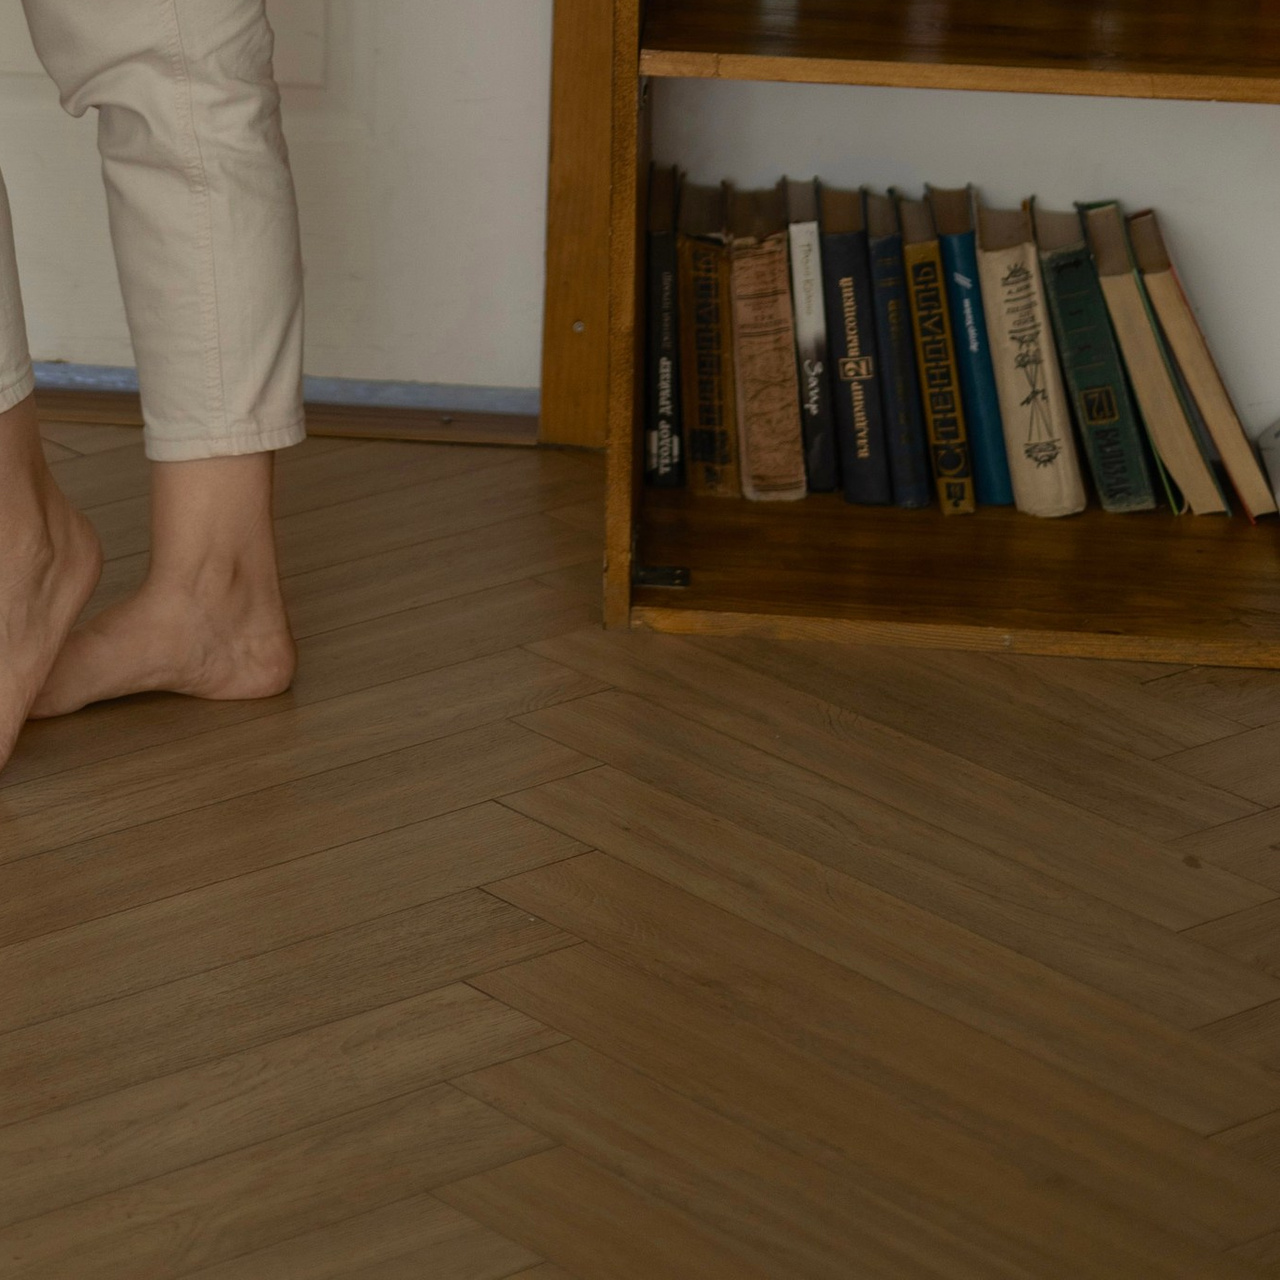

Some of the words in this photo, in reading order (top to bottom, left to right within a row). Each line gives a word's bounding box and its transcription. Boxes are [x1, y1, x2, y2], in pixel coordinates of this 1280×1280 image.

[839, 276, 862, 357] ВЫСОЦКИЙ
[843, 359, 867, 377] 2
[658, 420, 672, 473] ТЕОДОР
[849, 380, 871, 458] ВЛАДИМИР
